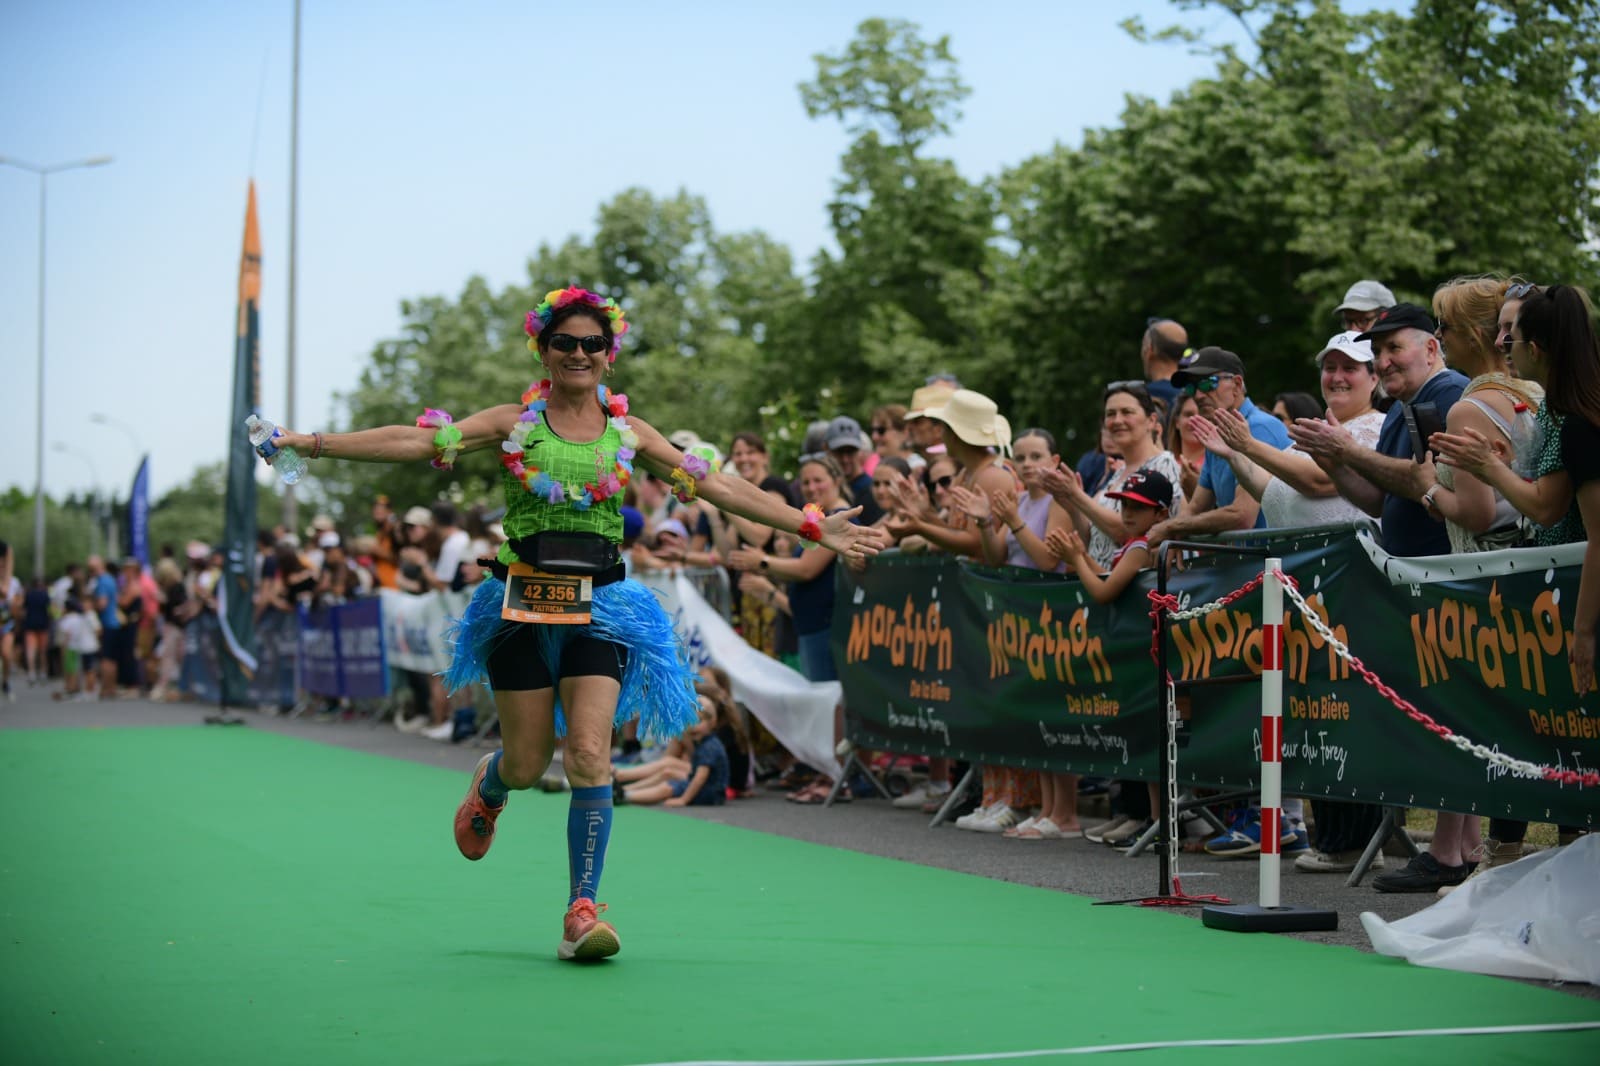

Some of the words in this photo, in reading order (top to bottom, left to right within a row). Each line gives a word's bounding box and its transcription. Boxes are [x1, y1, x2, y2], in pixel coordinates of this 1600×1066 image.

[524, 584, 543, 600] 42
[546, 585, 577, 602] 356
[532, 604, 565, 613] PATRICIA
[847, 593, 952, 672] Marathon
[987, 600, 1112, 685] Marathon
[1171, 594, 1349, 684] Marahon
[1066, 694, 1081, 714] De
[1081, 694, 1092, 715] la
[1289, 695, 1306, 720] De
[1307, 695, 1319, 720] la
[1320, 692, 1350, 721] Bière
[1529, 709, 1550, 736] De
[1550, 709, 1566, 736] la
[1567, 707, 1600, 739] Bièr
[1302, 729, 1318, 765] du
[1318, 731, 1348, 782] Forez
